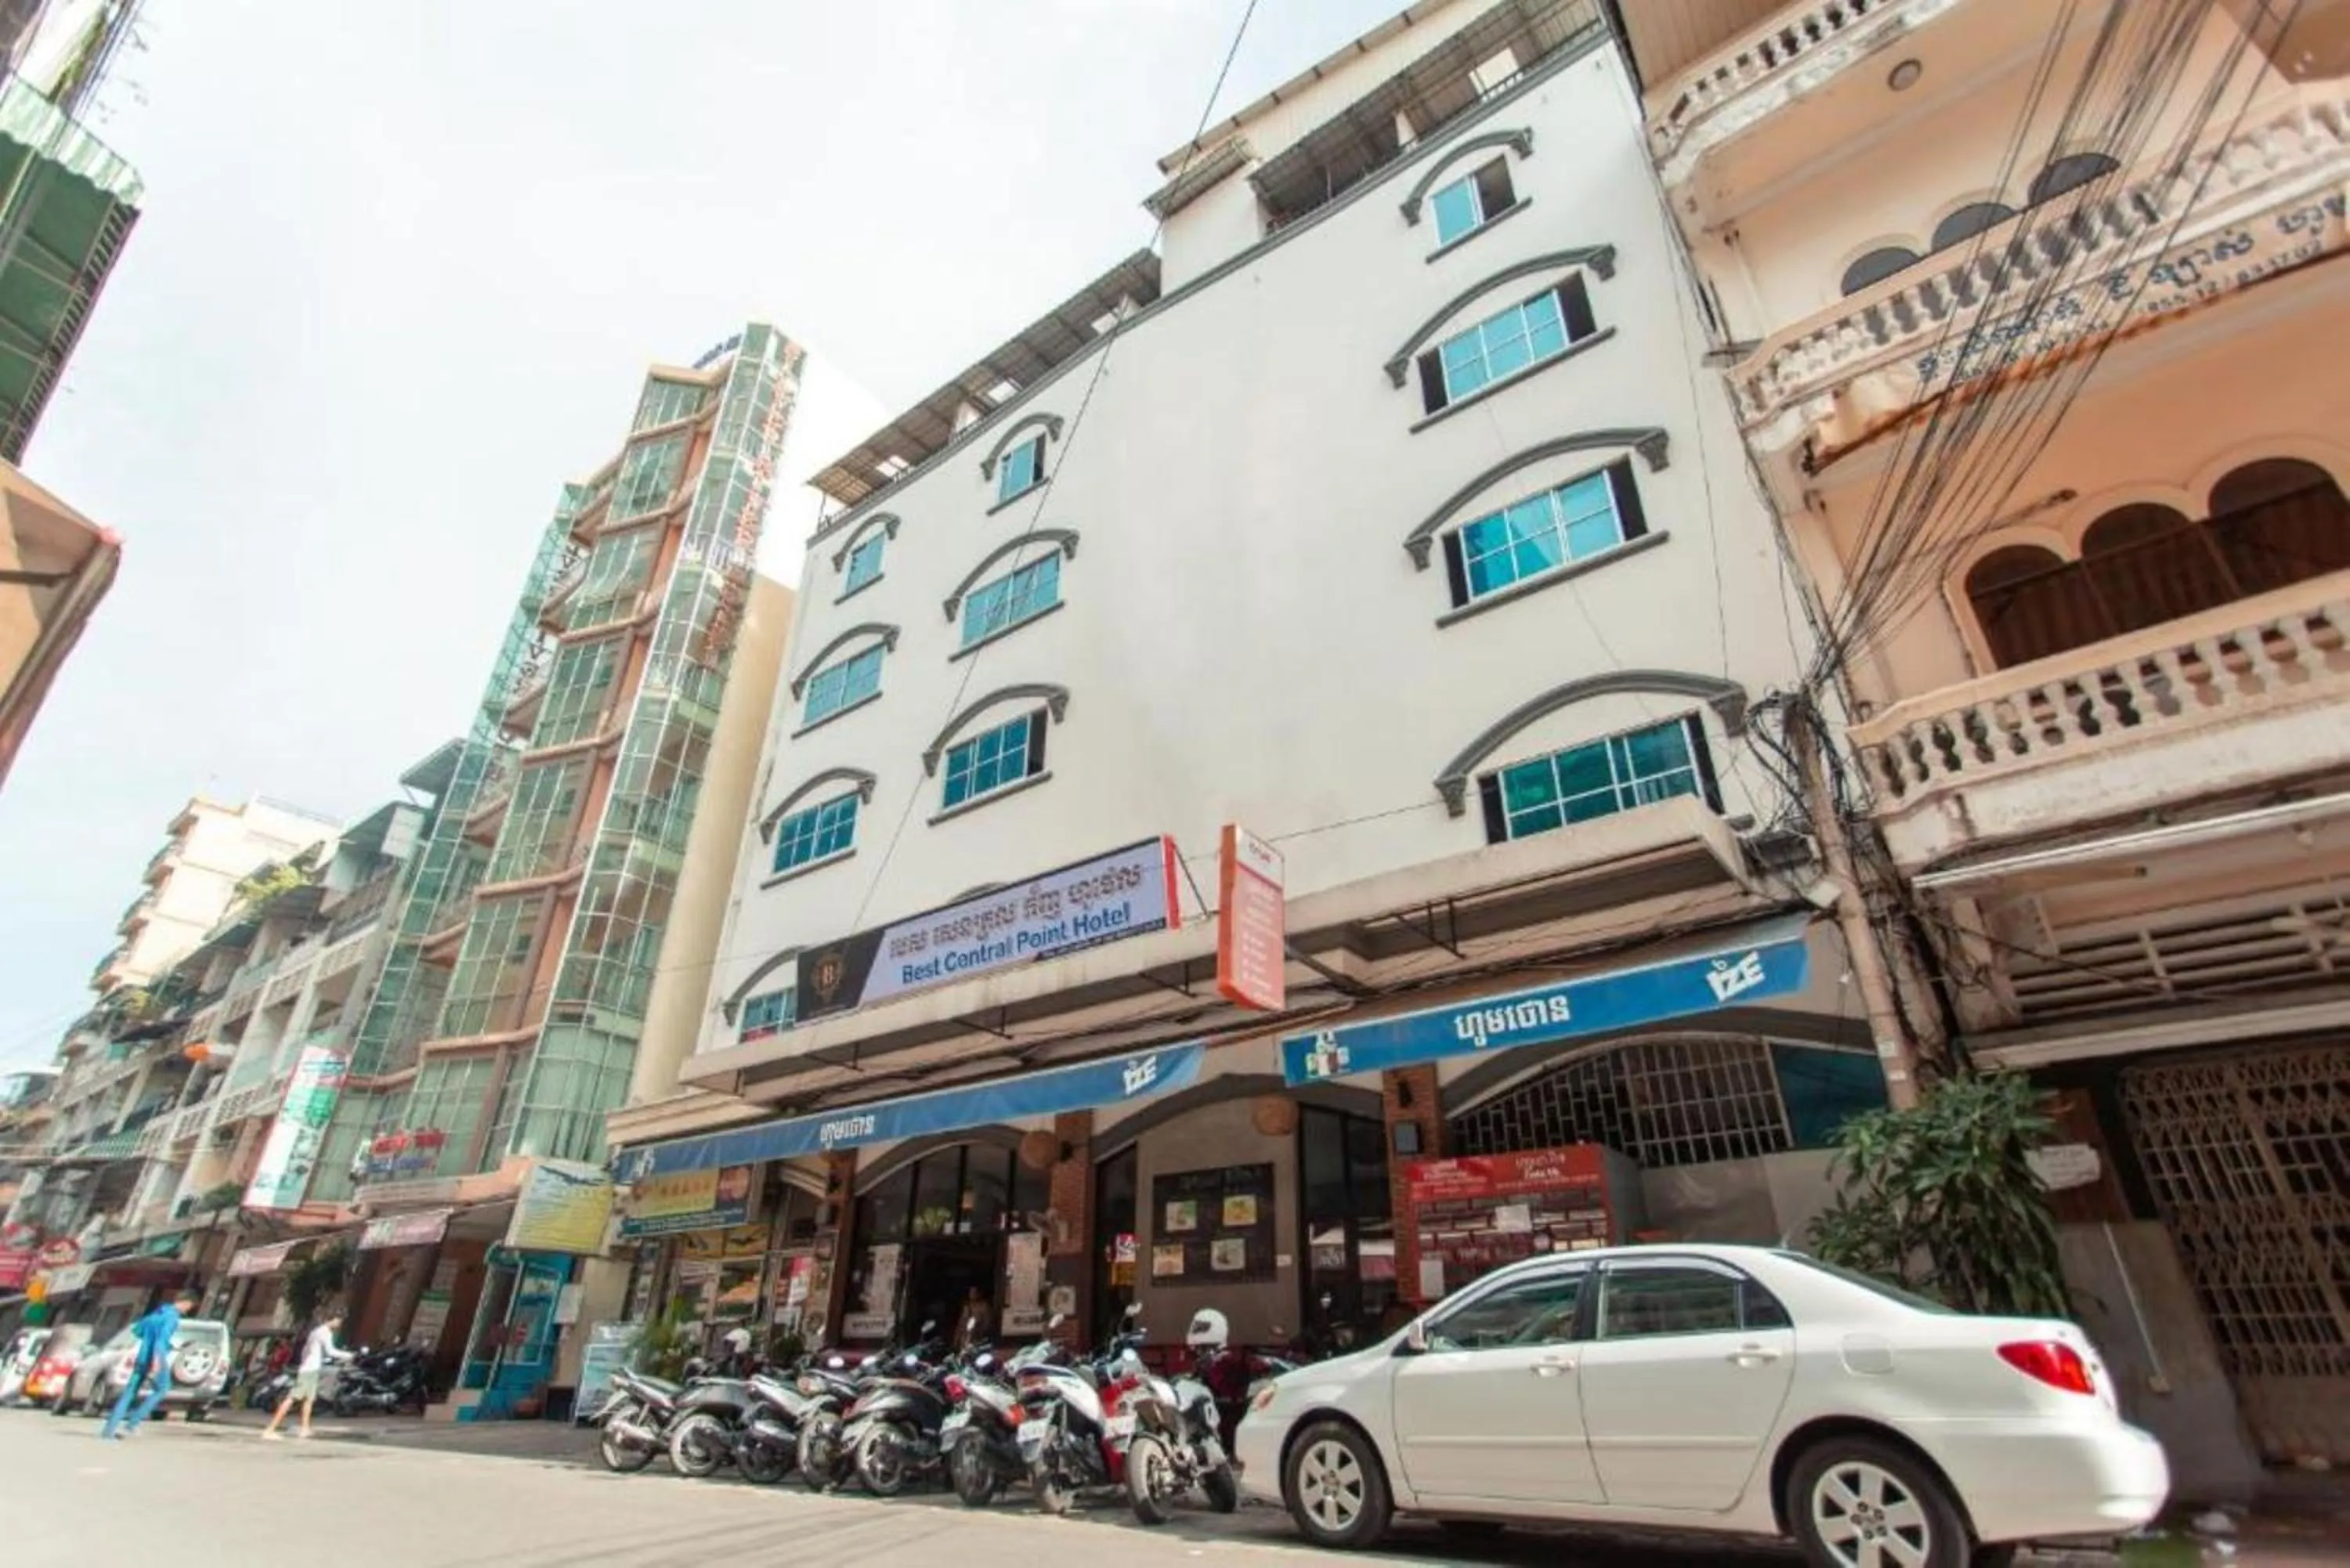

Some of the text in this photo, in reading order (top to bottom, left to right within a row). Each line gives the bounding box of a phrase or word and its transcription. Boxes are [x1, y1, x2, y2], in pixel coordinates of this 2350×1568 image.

[902, 956, 940, 984] Best
[944, 936, 1013, 972] Central
[1017, 920, 1067, 953] Point
[1072, 901, 1130, 938] Hotel
